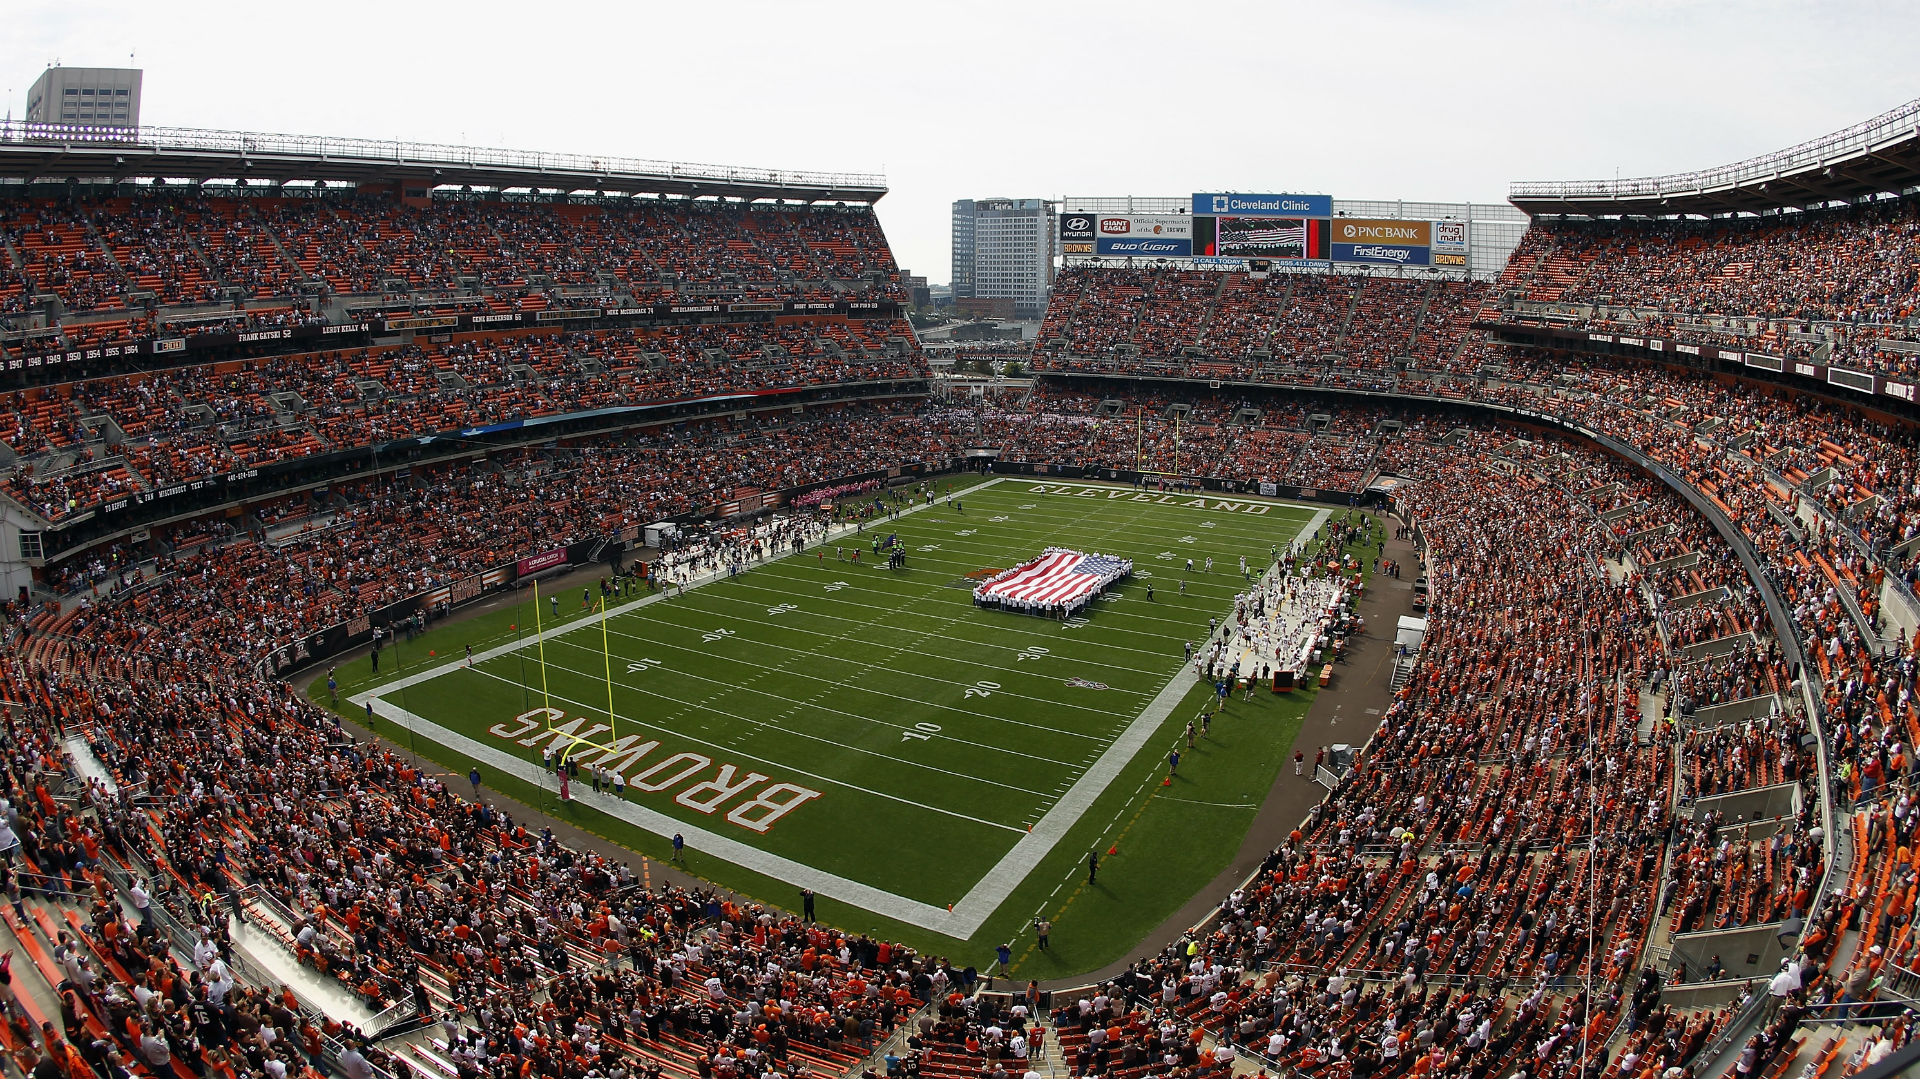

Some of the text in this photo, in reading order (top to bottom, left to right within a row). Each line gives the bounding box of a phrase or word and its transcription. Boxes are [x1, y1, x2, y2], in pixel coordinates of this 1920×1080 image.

[1230, 200, 1310, 211] Cleveland Clinic
[1358, 227, 1418, 239] PNC BANK
[1439, 223, 1460, 235] drug
[1064, 244, 1092, 253] BROWNS
[1353, 245, 1410, 259] FirstEnergy
[1435, 254, 1466, 265] BROWNS
[323, 326, 340, 334] LEROY
[361, 323, 369, 332] 44
[238, 329, 291, 342] FRANK GATSKI 52
[9, 359, 23, 370] 1947
[28, 357, 41, 367] 1948
[46, 354, 60, 364] 1949
[67, 352, 81, 361] 1950
[87, 349, 100, 358] 1954
[106, 347, 119, 356] 1955
[124, 346, 138, 354] 1964
[191, 481, 203, 490] TEXT
[1028, 485, 1271, 514] CLEVELAND
[769, 603, 798, 614] 30
[704, 628, 735, 642] 20
[1018, 647, 1049, 660] 30
[628, 658, 661, 671] 10
[966, 681, 1000, 698] 20
[902, 722, 941, 741] 10
[488, 707, 823, 834] BROWNS
[194, 1011, 210, 1024] 16
